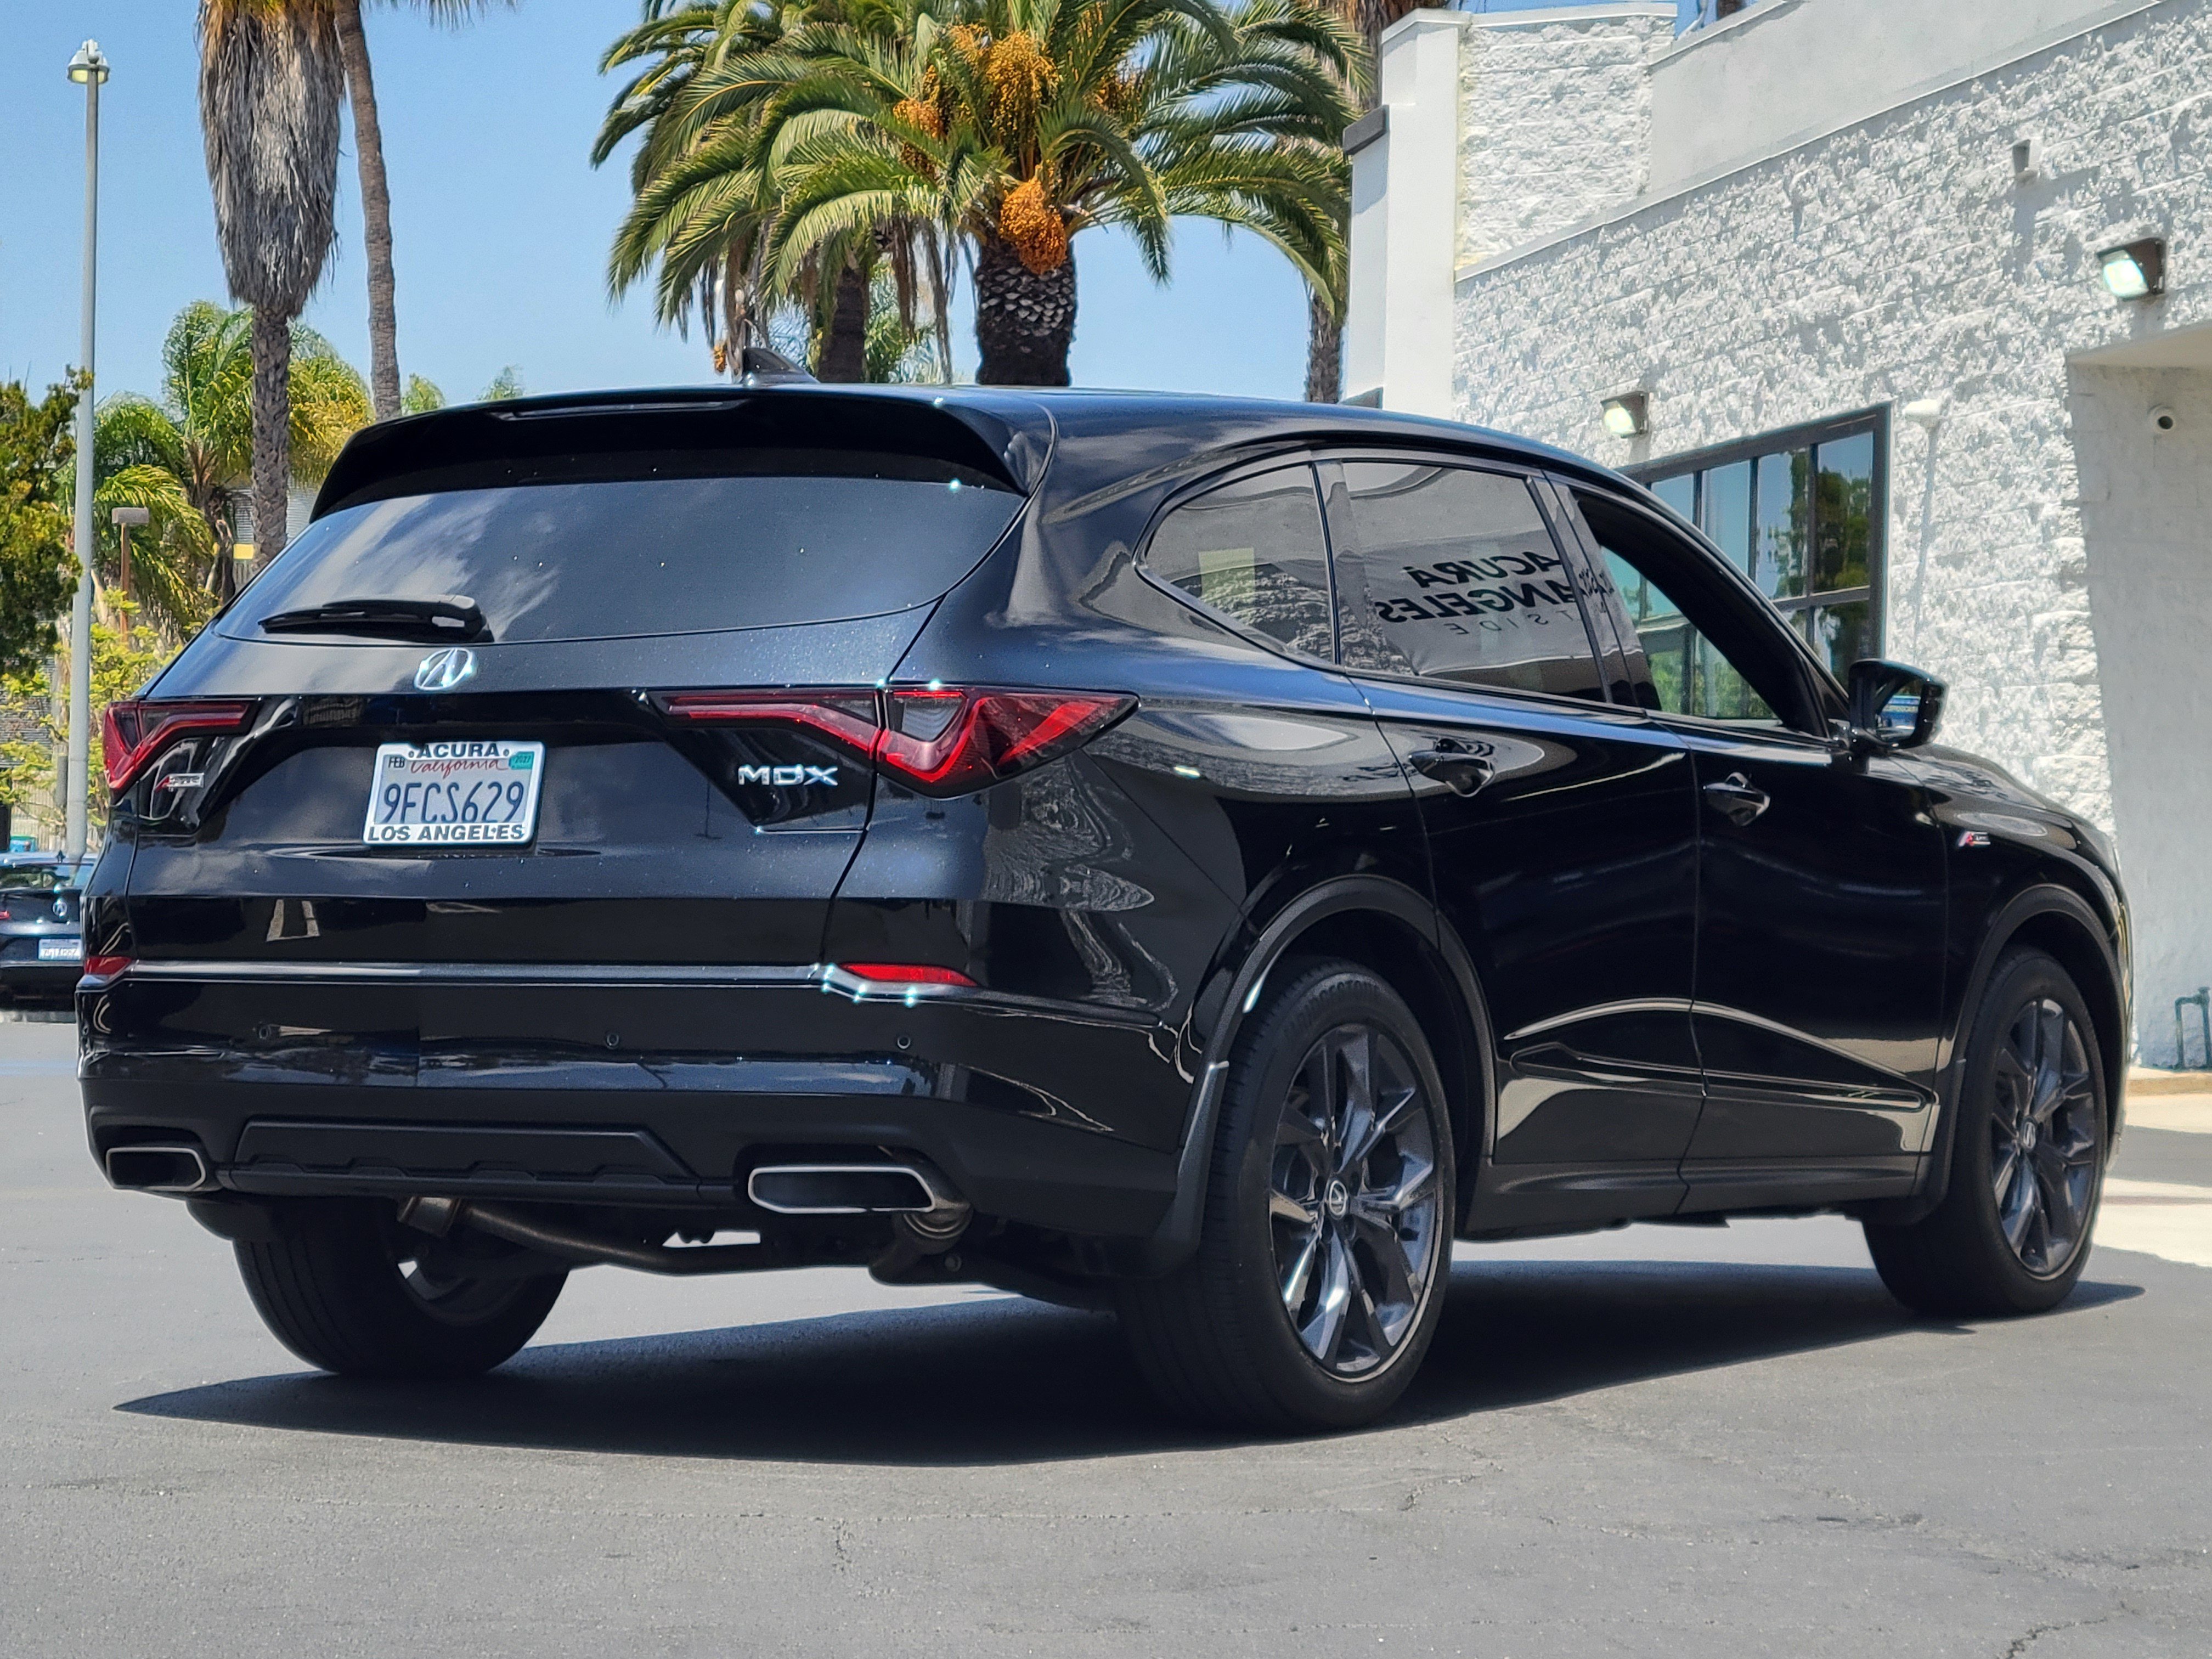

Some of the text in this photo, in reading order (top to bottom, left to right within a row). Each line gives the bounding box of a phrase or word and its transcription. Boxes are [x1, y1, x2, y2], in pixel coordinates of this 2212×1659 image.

[416, 743, 500, 758] ACURA
[388, 756, 405, 768] FEB
[410, 759, 508, 778] California
[738, 765, 838, 786] MDX
[383, 781, 524, 823] 9FCS629
[368, 824, 525, 841] LOS ANGELES
